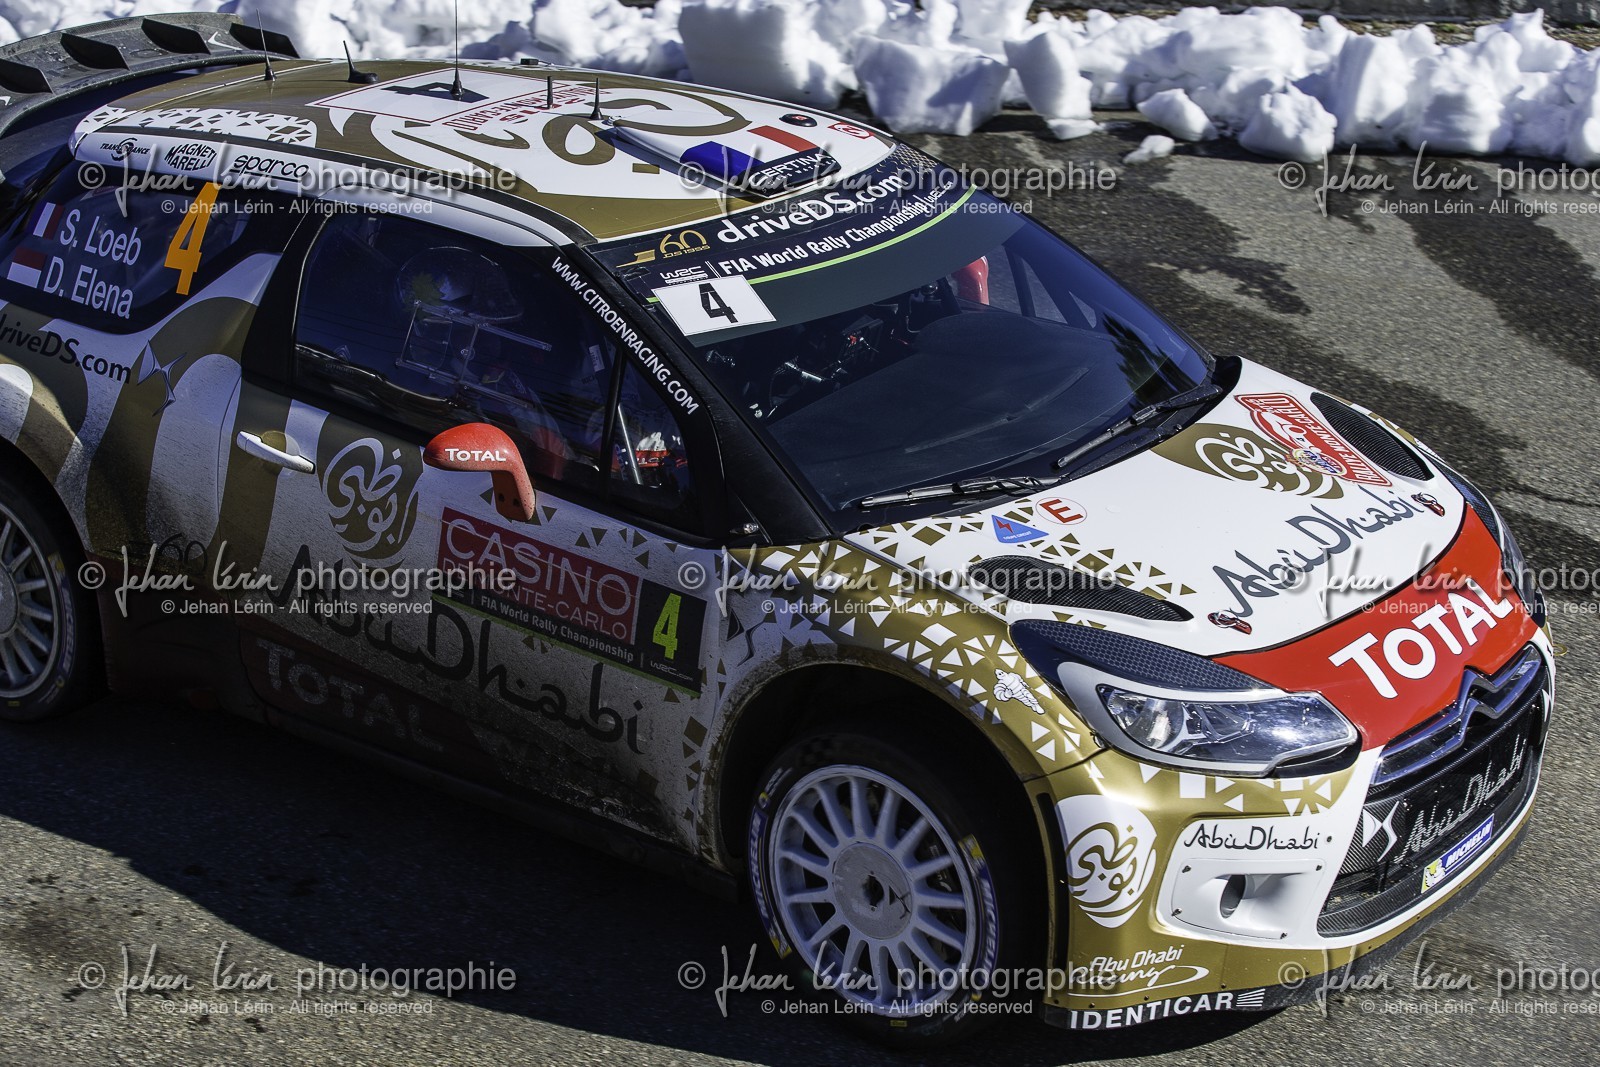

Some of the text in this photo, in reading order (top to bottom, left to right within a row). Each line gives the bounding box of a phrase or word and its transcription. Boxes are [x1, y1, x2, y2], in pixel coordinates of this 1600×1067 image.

[231, 154, 310, 180] sparco
[749, 153, 832, 187] CERTINA
[60, 208, 142, 266] S. Loeb
[164, 181, 221, 295] 4
[717, 172, 909, 243] driveDS.com
[718, 257, 758, 275] FIA
[752, 245, 809, 267] World
[807, 236, 851, 254] Rally
[845, 201, 930, 242] Championship
[660, 230, 707, 254] 60
[660, 266, 706, 279] WRC
[43, 255, 134, 320] D. Elena
[698, 282, 739, 324] 4
[0, 314, 131, 384] riveDS.com
[551, 256, 700, 415] WWW.CITROENRACING.COM
[445, 447, 508, 463] TOTAL
[1339, 451, 1382, 482] RALLYE
[1039, 498, 1084, 523] E
[446, 517, 632, 616] CASINO
[480, 595, 498, 611] FIA
[500, 601, 529, 623] World
[531, 615, 558, 635] Rally
[560, 625, 635, 664] Championship
[652, 592, 682, 660] 4
[1328, 577, 1515, 699] TOTAL
[255, 637, 447, 753] TOTAL
[1089, 944, 1185, 973] Abu Dhabi
[1070, 991, 1234, 1029] IDENTICAR
